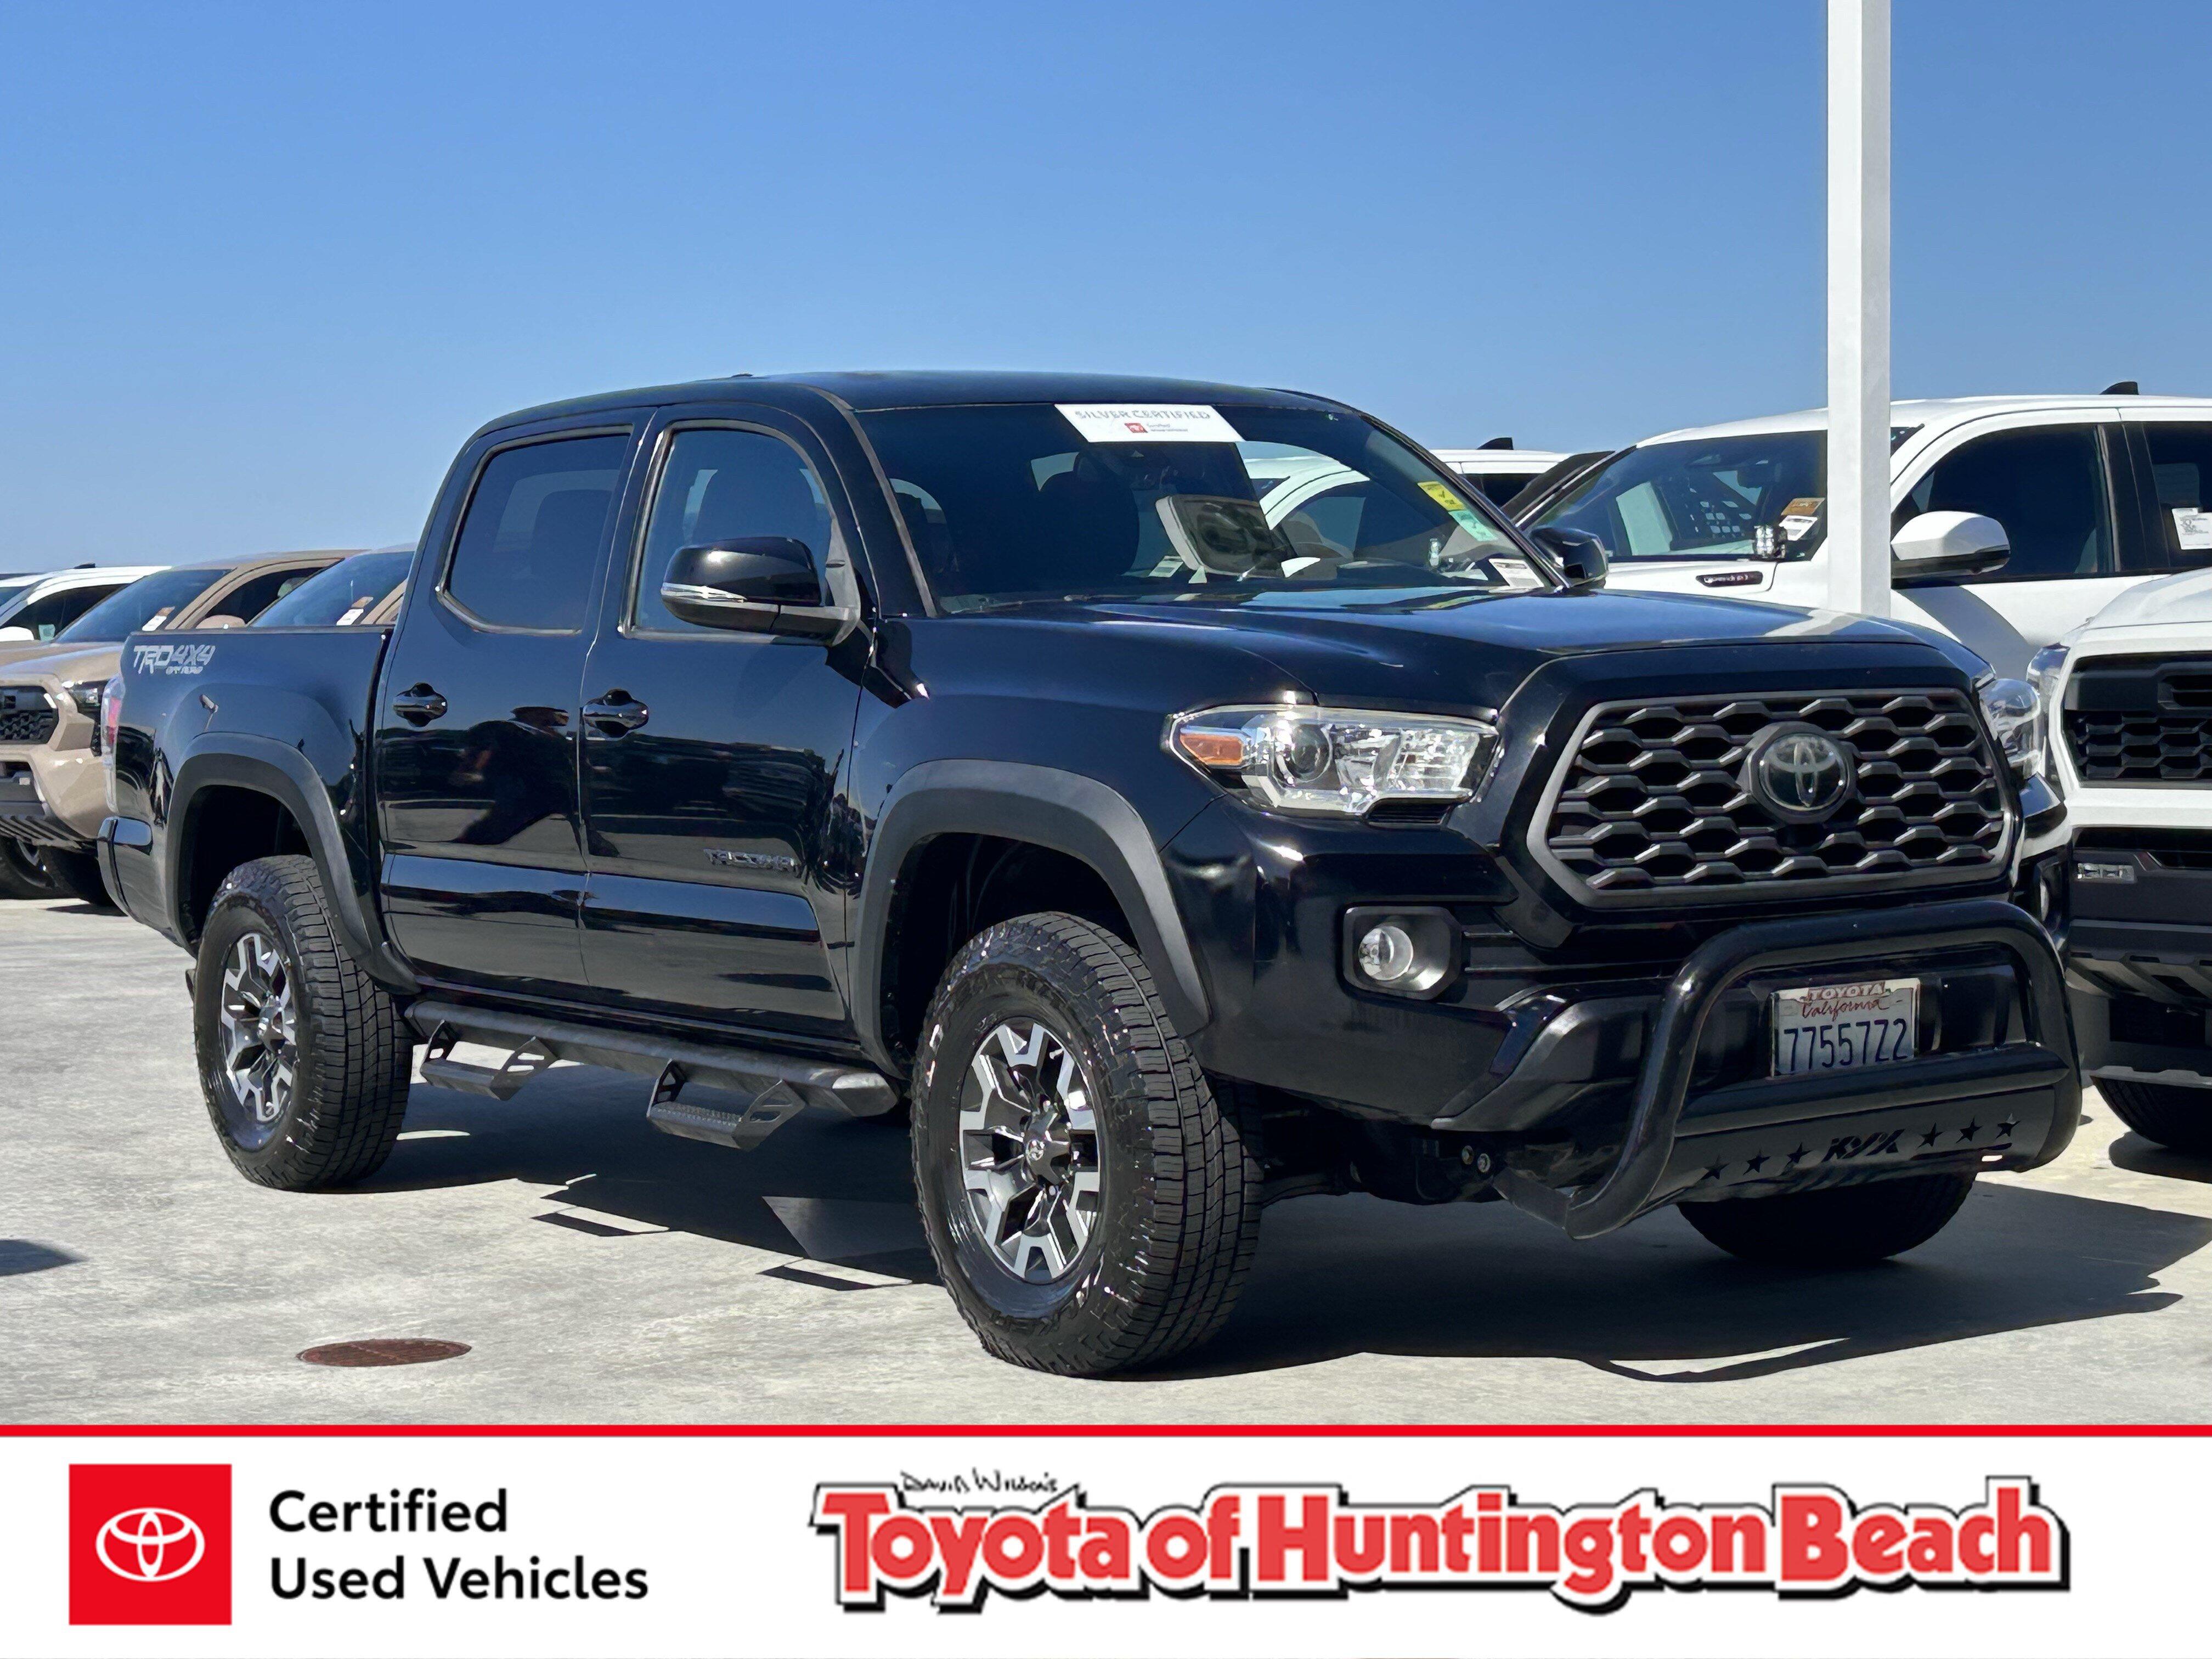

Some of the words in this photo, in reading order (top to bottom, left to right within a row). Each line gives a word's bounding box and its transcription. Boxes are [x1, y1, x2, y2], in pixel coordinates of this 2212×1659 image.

[1075, 410, 1132, 419] SILVER
[1132, 410, 1210, 419] CERTIFIED
[133, 645, 174, 674] TRD
[1810, 982, 1886, 1001] TOYOTA
[1801, 998, 1889, 1022] California
